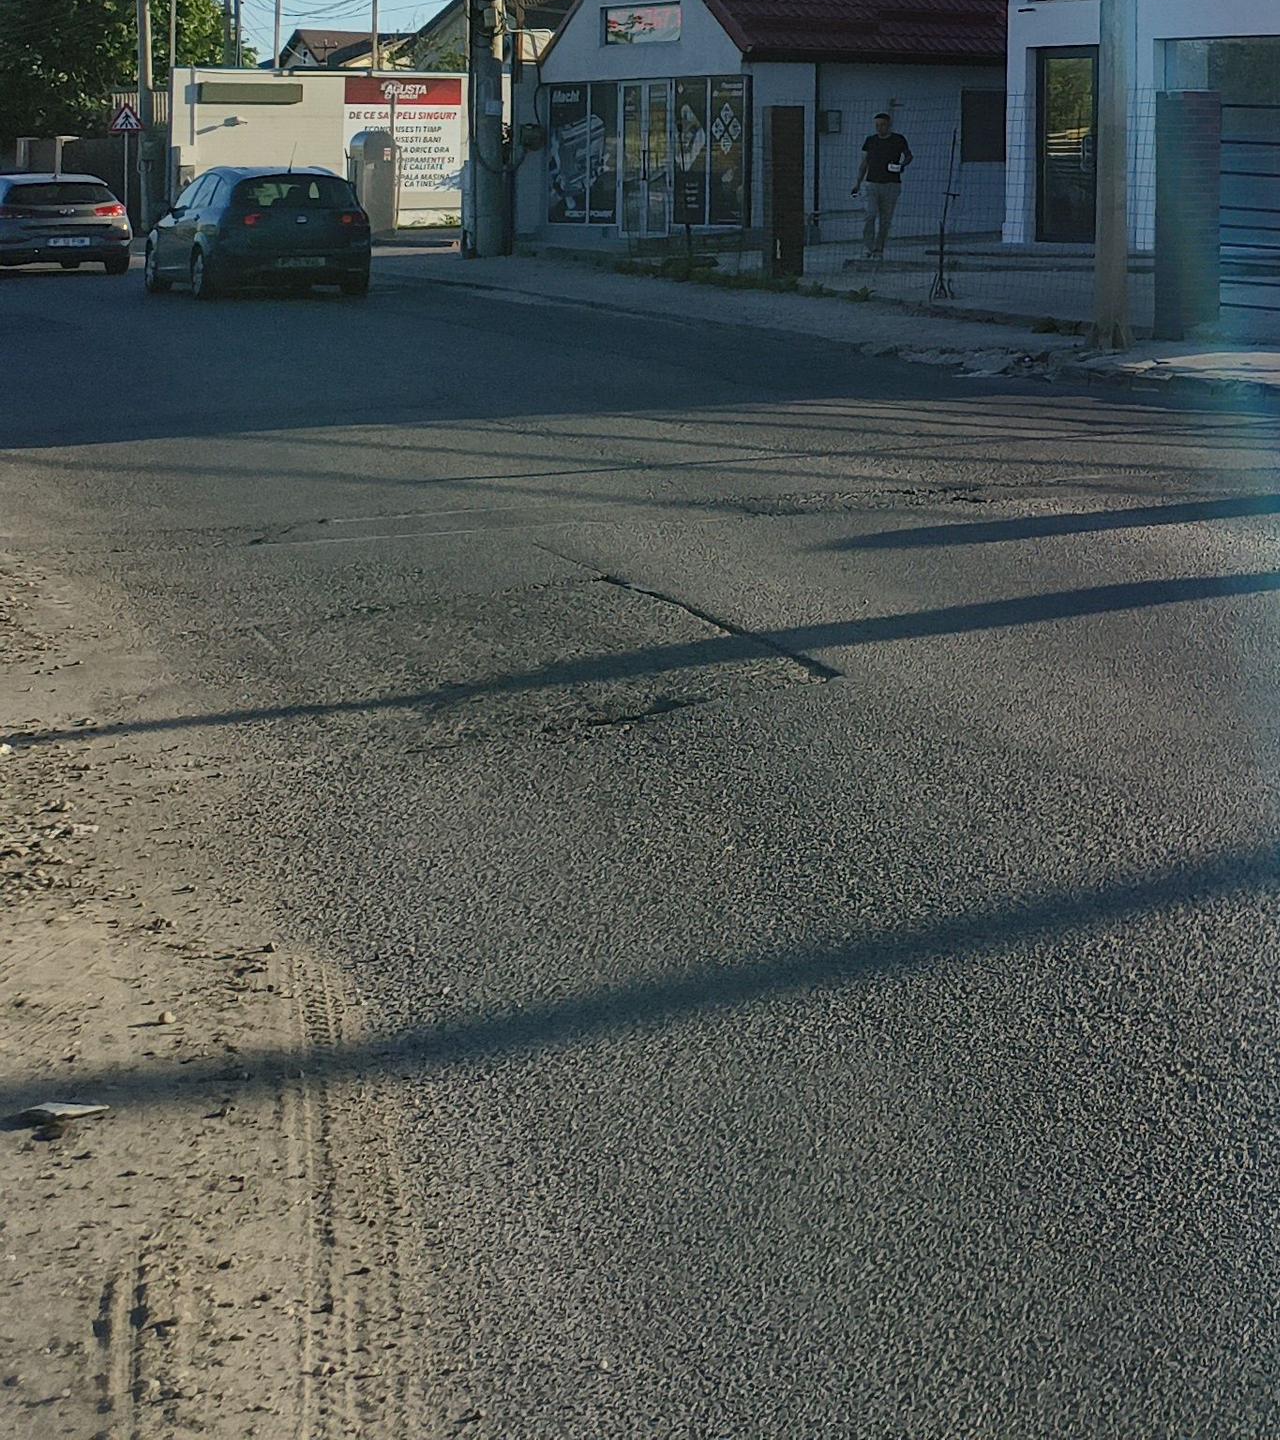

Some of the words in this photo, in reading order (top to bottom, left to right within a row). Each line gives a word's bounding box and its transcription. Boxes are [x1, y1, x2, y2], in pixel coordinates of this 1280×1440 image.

[349, 112, 361, 120] DE
[364, 112, 376, 120] CE
[392, 112, 416, 120] PELI
[418, 112, 456, 120] SINGUR?
